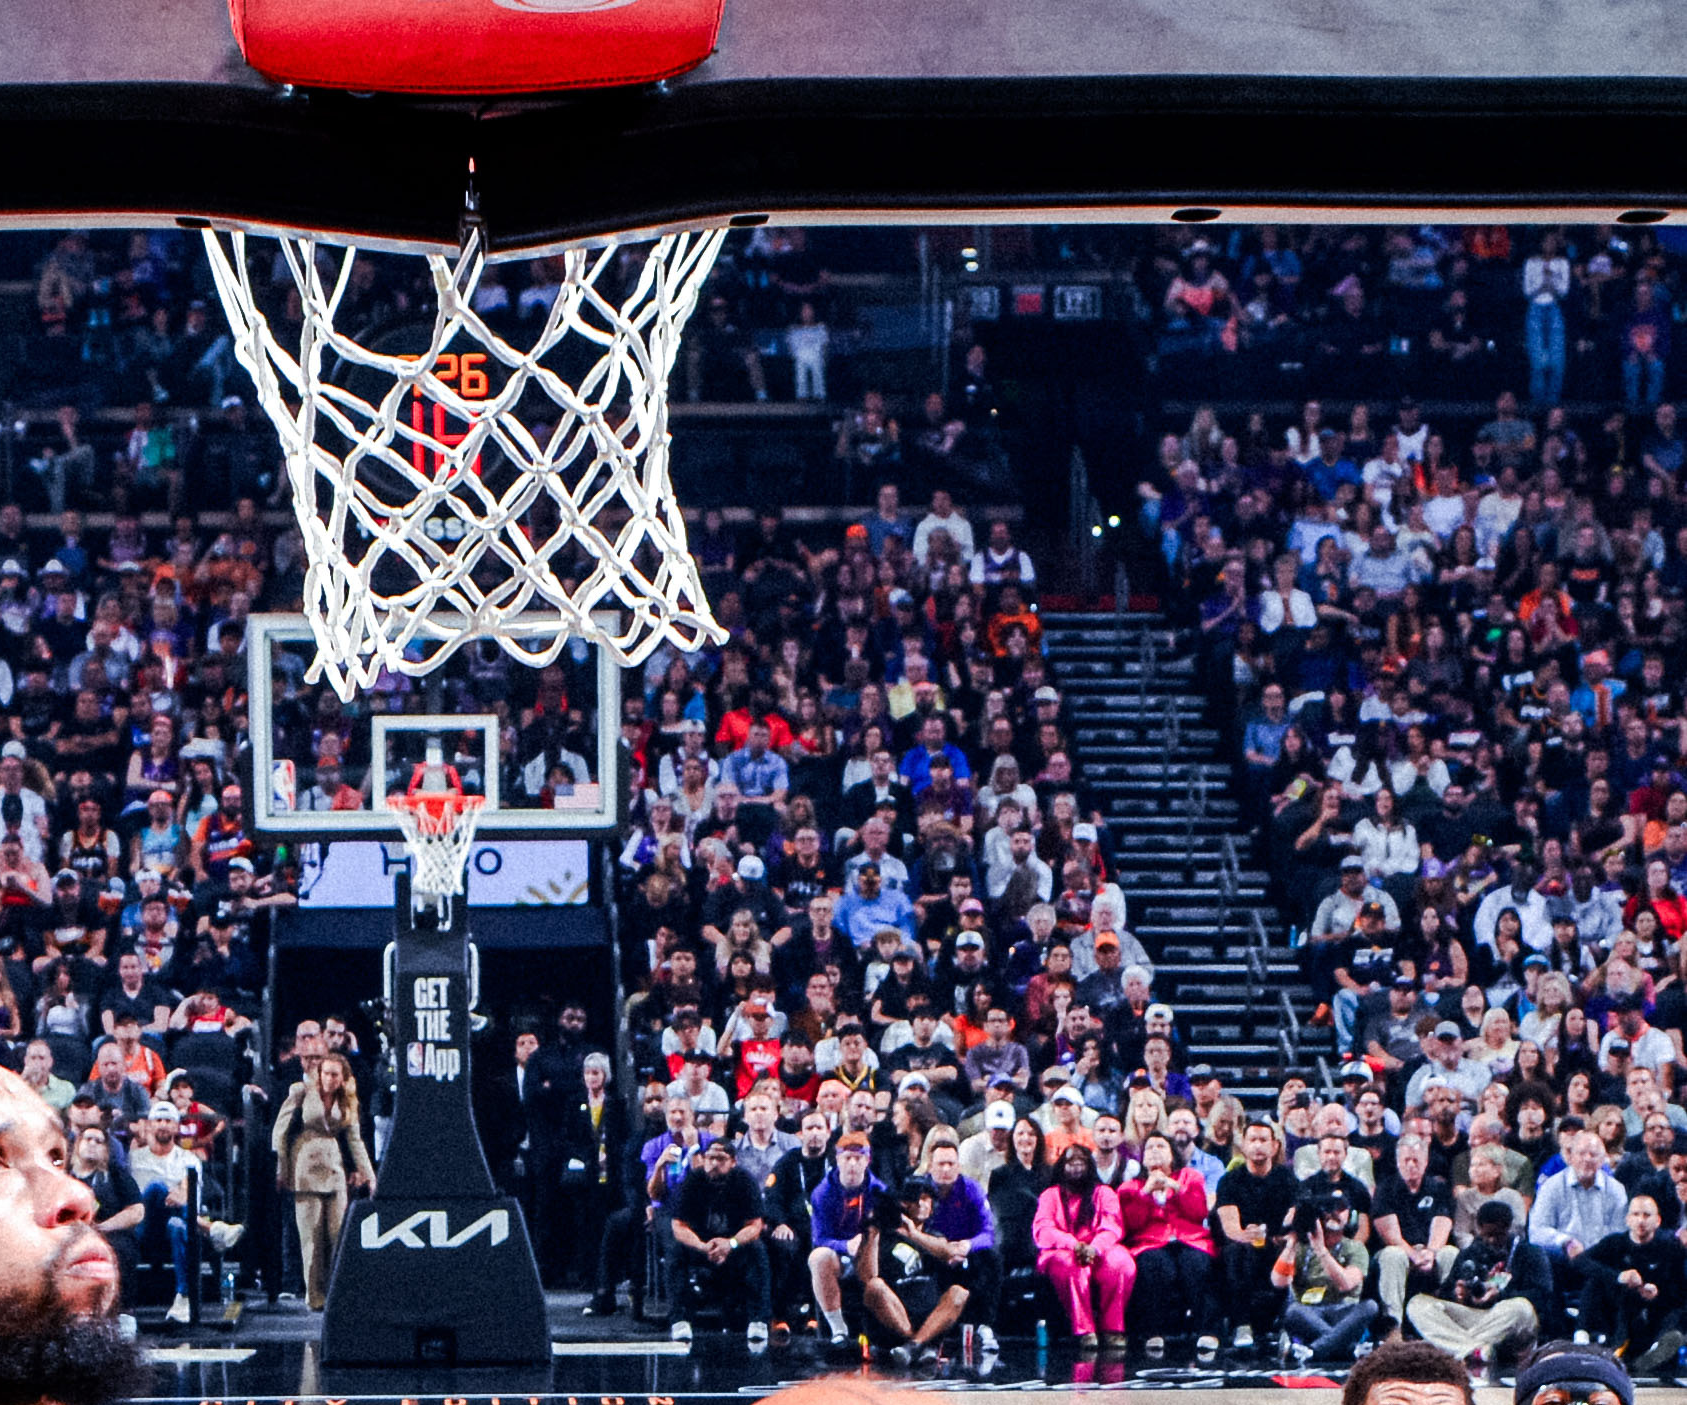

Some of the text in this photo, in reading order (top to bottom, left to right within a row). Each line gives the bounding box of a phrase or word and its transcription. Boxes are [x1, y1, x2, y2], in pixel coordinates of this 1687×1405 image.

[414, 977, 450, 1009] GET
[415, 1009, 452, 1042] THE
[424, 1042, 461, 1082] App
